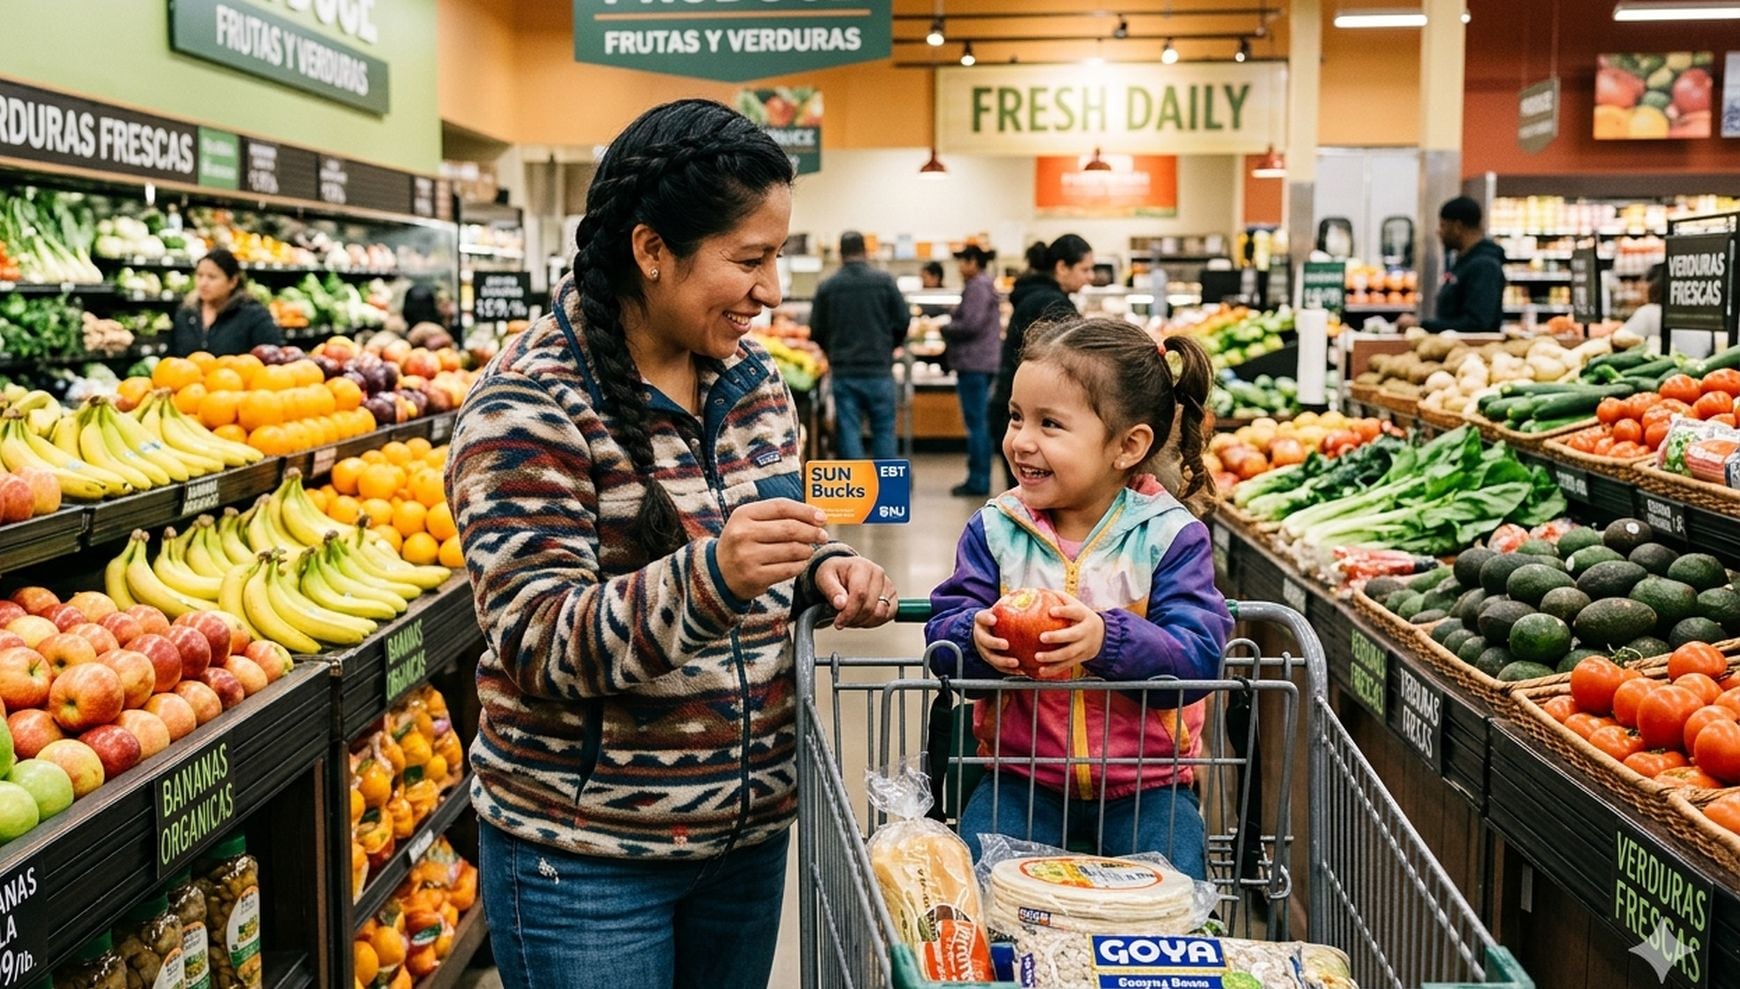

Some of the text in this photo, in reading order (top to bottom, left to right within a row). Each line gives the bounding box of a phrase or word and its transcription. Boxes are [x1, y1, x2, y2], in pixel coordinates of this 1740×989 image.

[216, 4, 283, 66] FRUTAS
[283, 30, 297, 70] Y
[297, 37, 369, 96] VERDURAS
[604, 26, 862, 55] FRUTAS Y VERDURAS
[971, 83, 1252, 133] FRESH DAILY
[100, 116, 194, 174] FRESCAS
[811, 467, 851, 481] SUN
[811, 483, 866, 498] Bucks
[163, 743, 228, 817] BANANAS
[161, 782, 234, 865] ORGANICAS
[1617, 831, 1707, 932] VERDURAS
[1099, 939, 1219, 964] GOYA
[1615, 879, 1700, 983] FRESCAS
